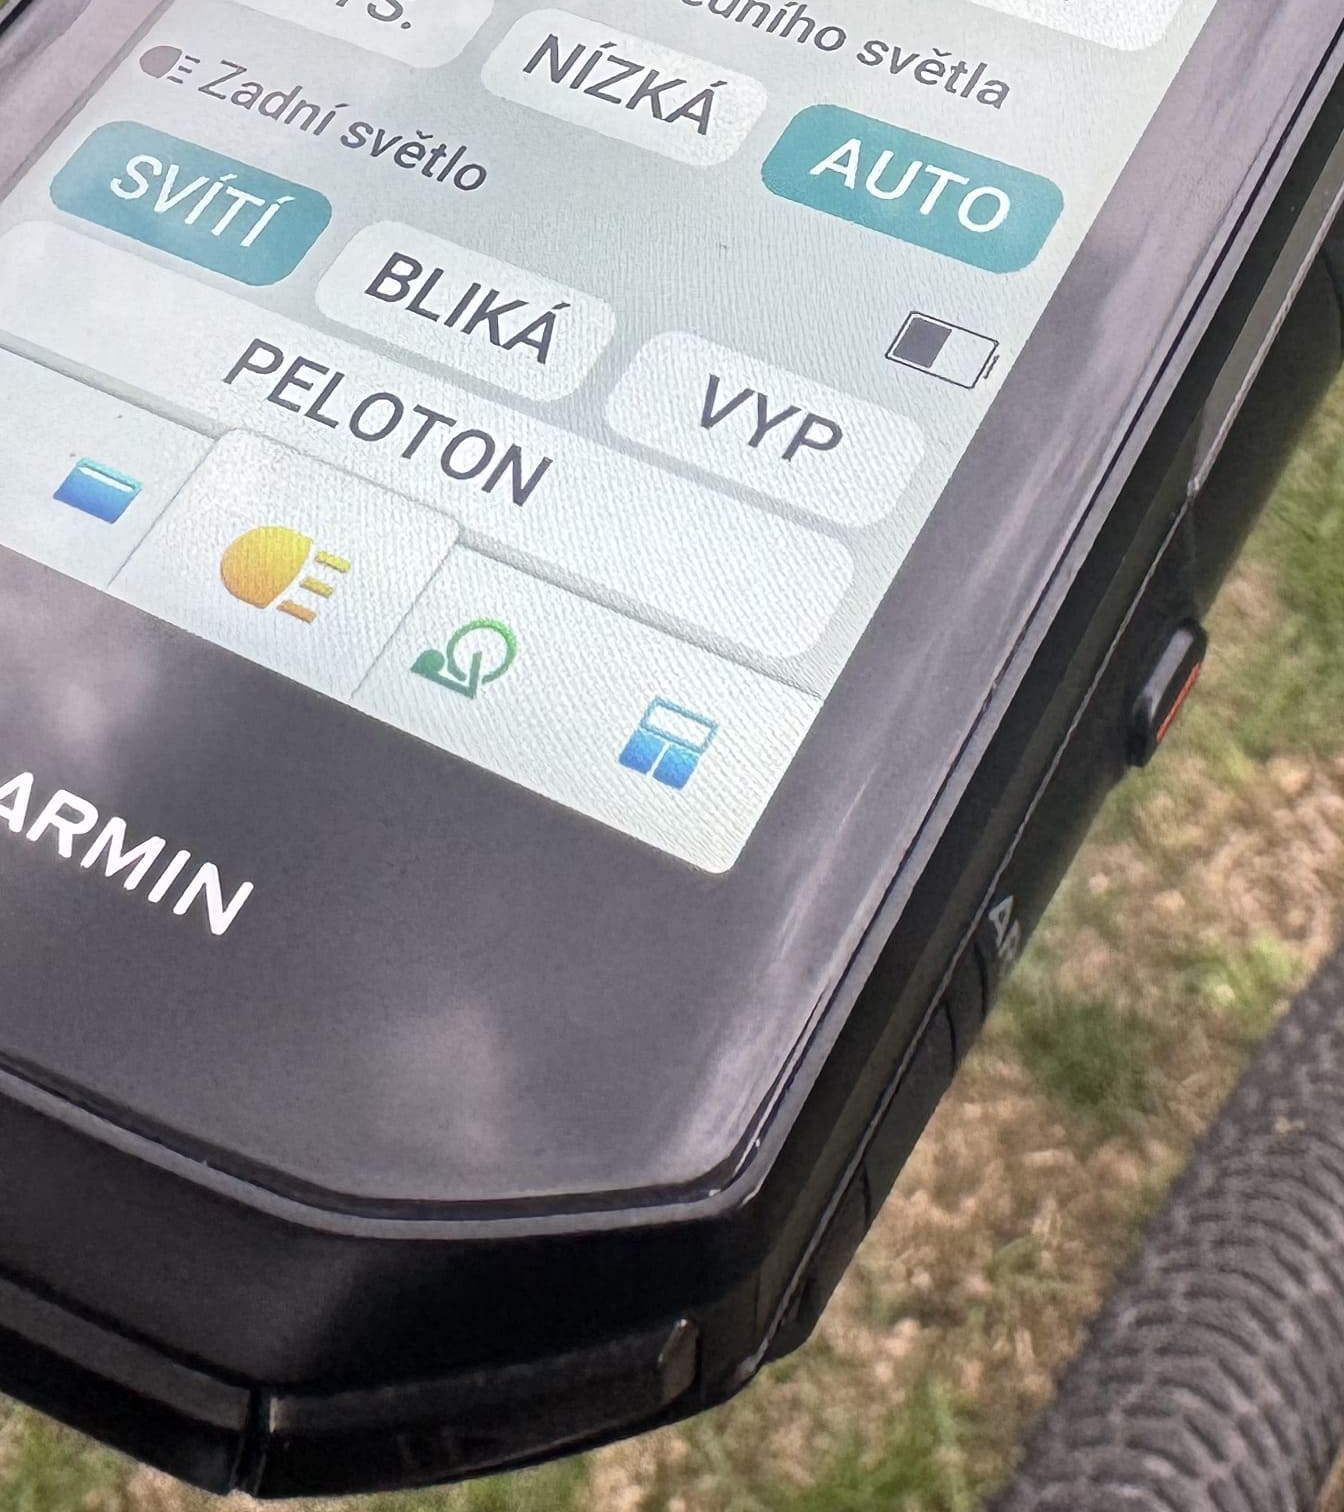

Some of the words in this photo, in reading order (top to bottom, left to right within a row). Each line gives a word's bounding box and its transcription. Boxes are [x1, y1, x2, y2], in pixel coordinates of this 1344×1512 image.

[522, 33, 727, 136] NÍZKÁ
[855, 38, 1011, 110] světla
[197, 59, 351, 138] Zadní
[340, 120, 489, 193] světlo
[109, 153, 294, 249] SVÍTÍ
[809, 137, 1013, 236] AUTO
[364, 251, 571, 366] BLIKÁ
[221, 338, 555, 508] PELOTON
[699, 373, 846, 464] VYP
